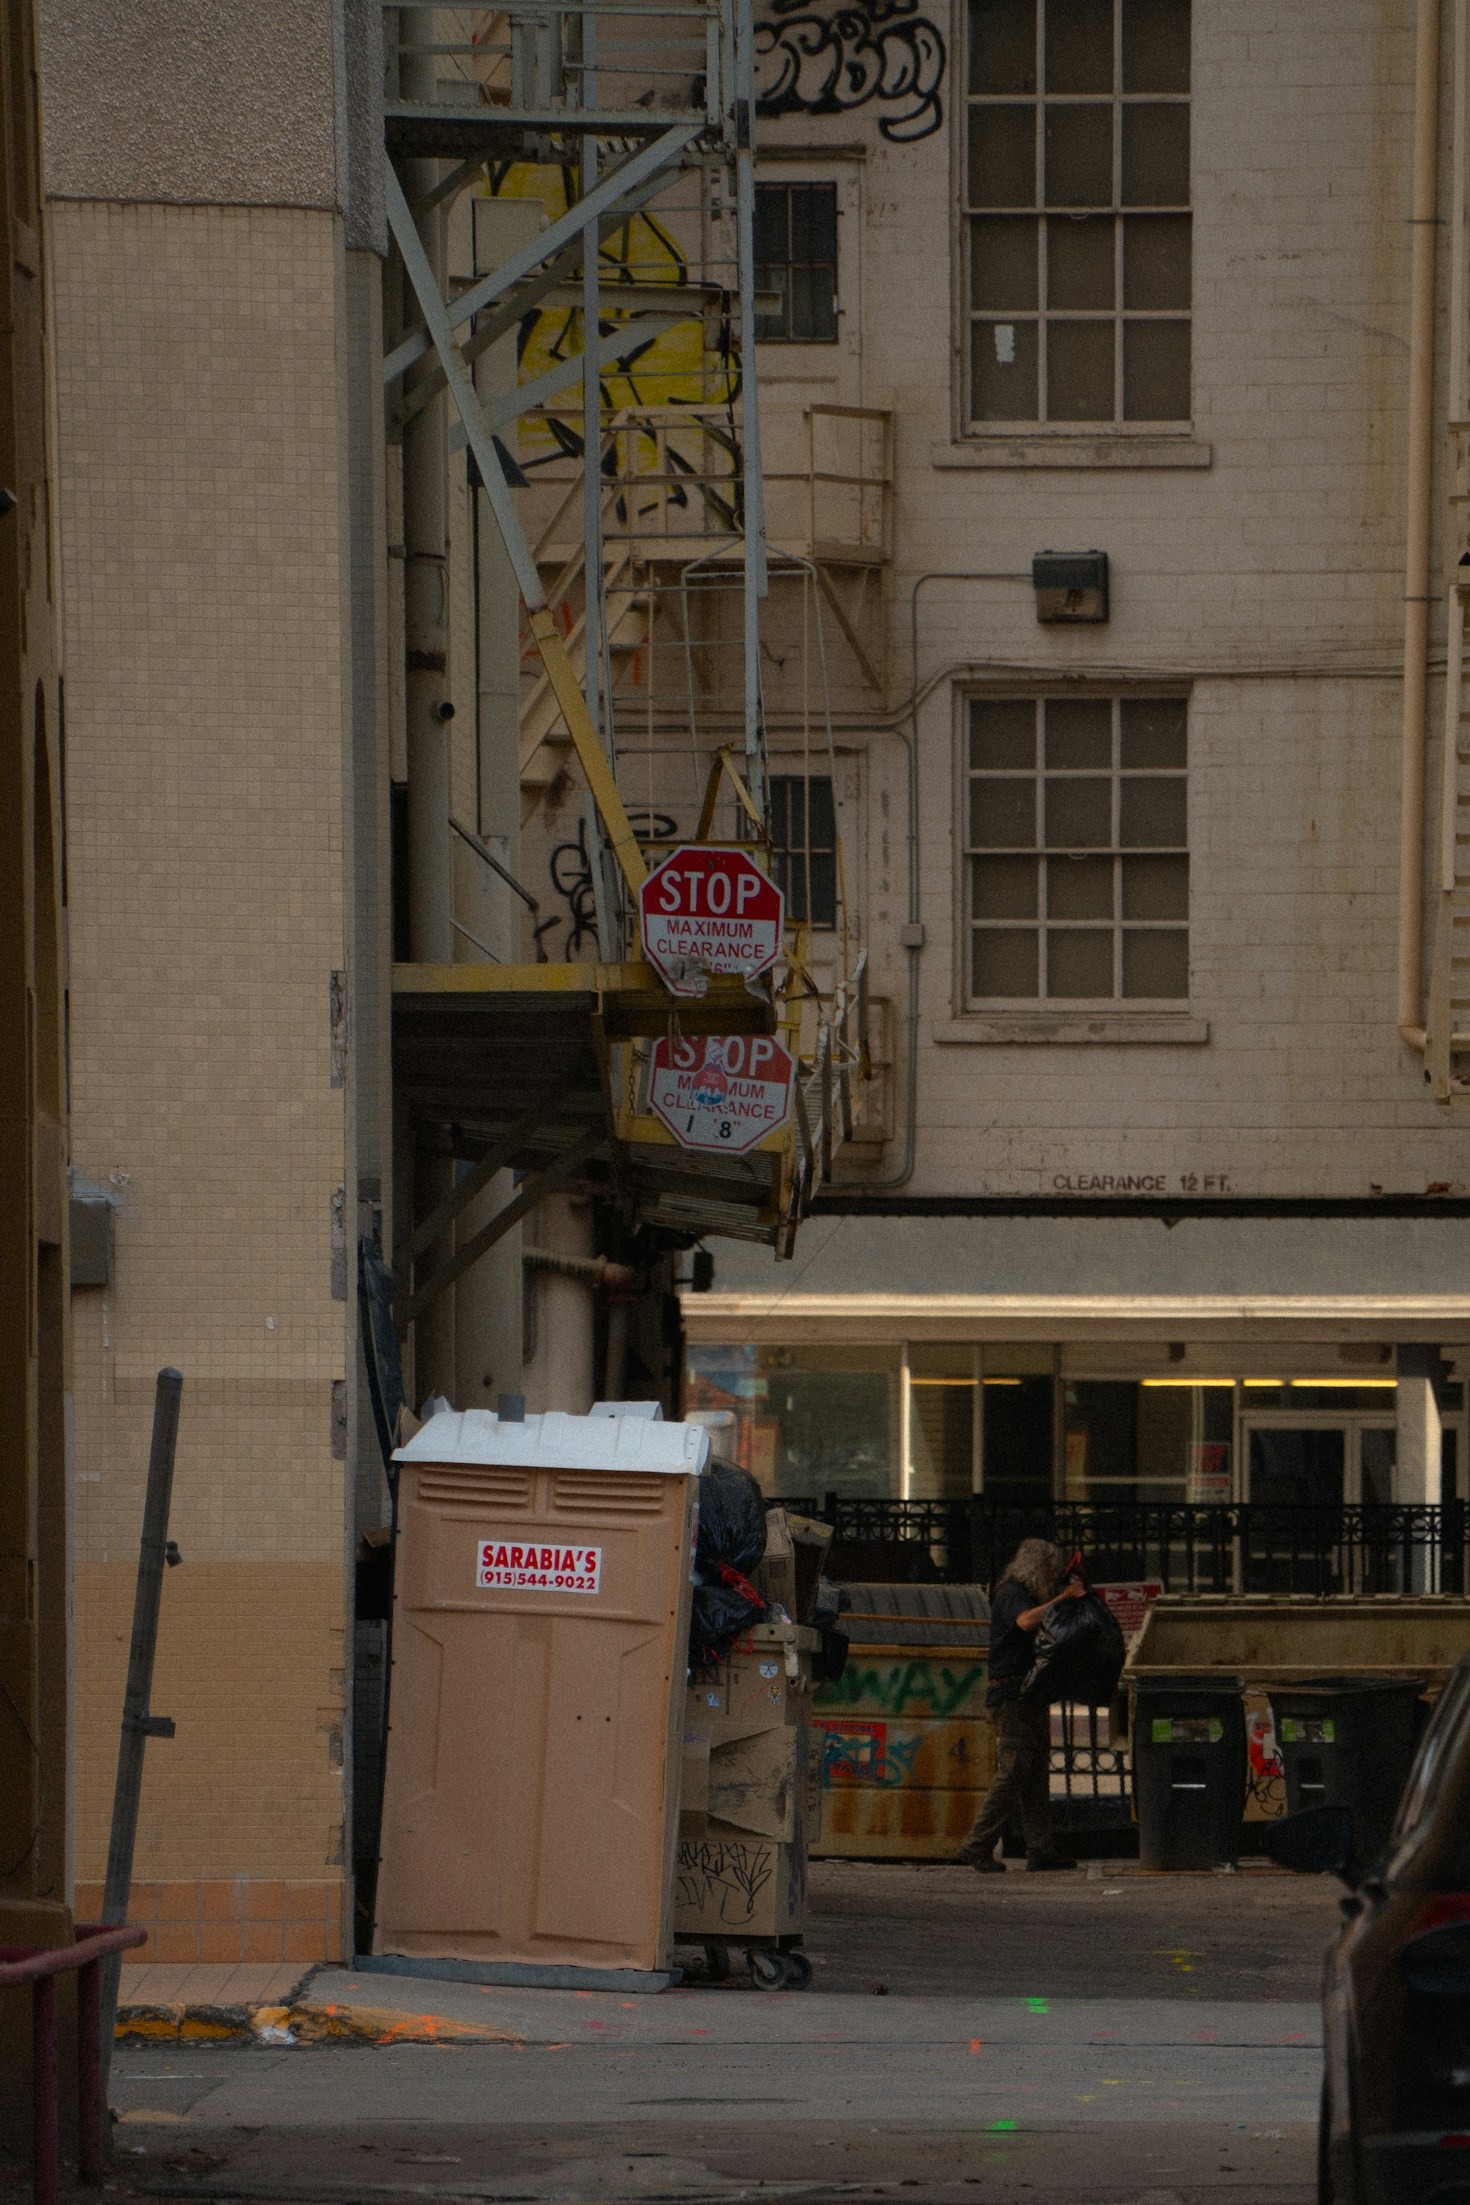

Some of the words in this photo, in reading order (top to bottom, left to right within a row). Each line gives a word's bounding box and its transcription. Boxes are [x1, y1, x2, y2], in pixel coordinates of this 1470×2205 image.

[659, 870, 760, 914] STOP
[667, 920, 753, 938] MAXIMUM
[657, 939, 764, 959] CLEARANCE
[678, 1075, 764, 1099] MMUM
[1053, 1174, 1166, 1191] CLEARANCE
[1180, 1173, 1197, 1191] 12
[1204, 1175, 1231, 1191] FT.
[482, 1545, 596, 1573] SARABIA'S
[480, 1570, 595, 1589] (915)544-9022
